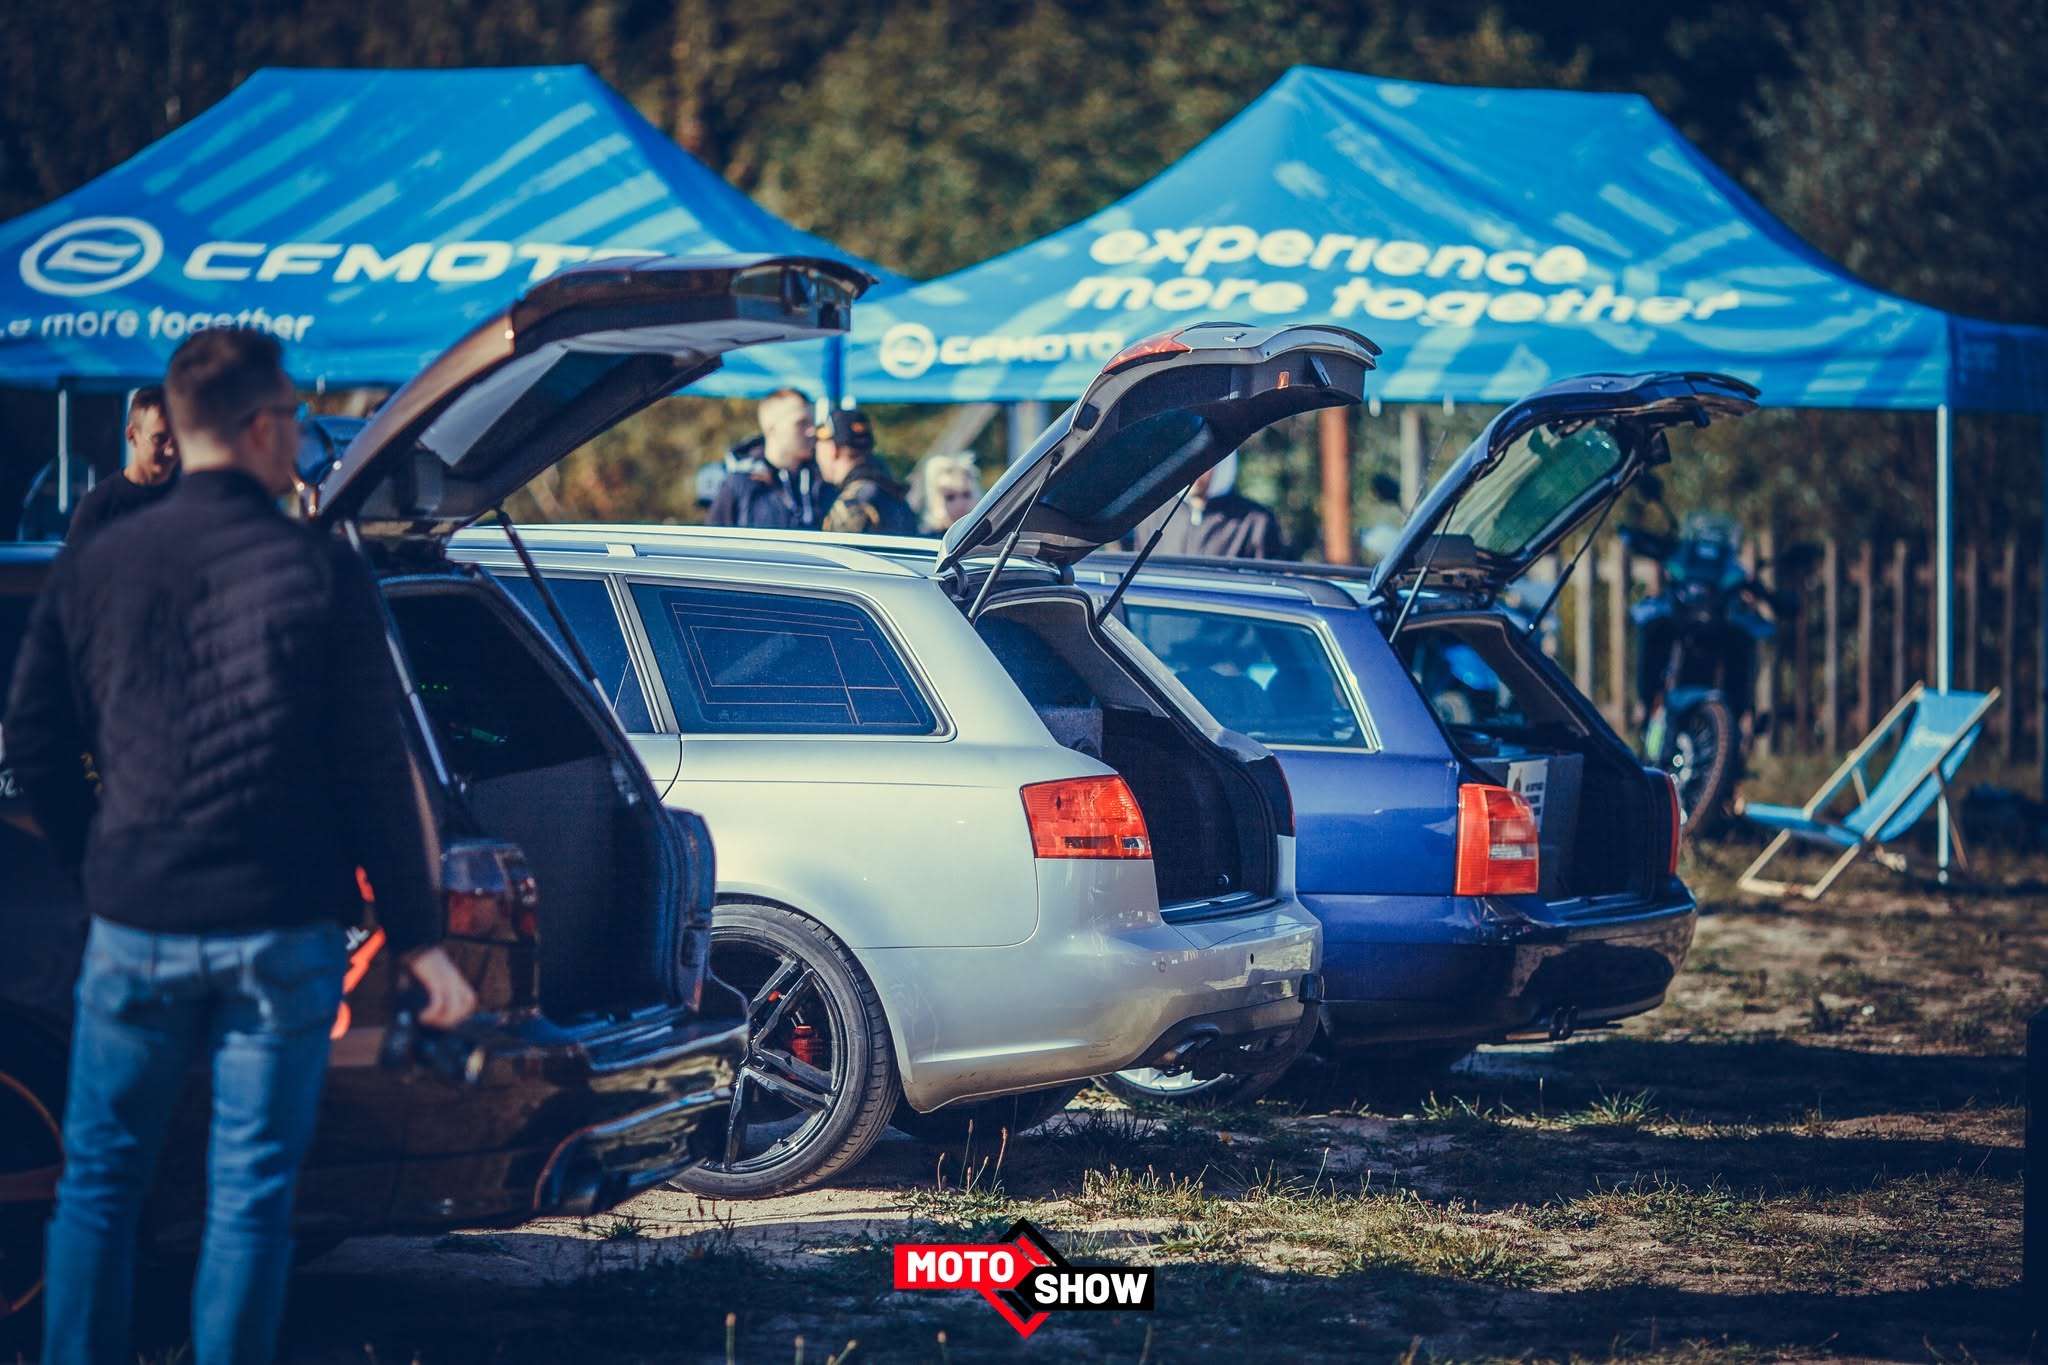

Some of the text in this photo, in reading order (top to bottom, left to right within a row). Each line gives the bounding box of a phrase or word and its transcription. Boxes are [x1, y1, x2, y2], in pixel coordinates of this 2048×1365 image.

[183, 241, 667, 283] CFMOT
[1090, 225, 1588, 284] experience
[41, 309, 139, 339] more
[1065, 275, 1740, 328] more together
